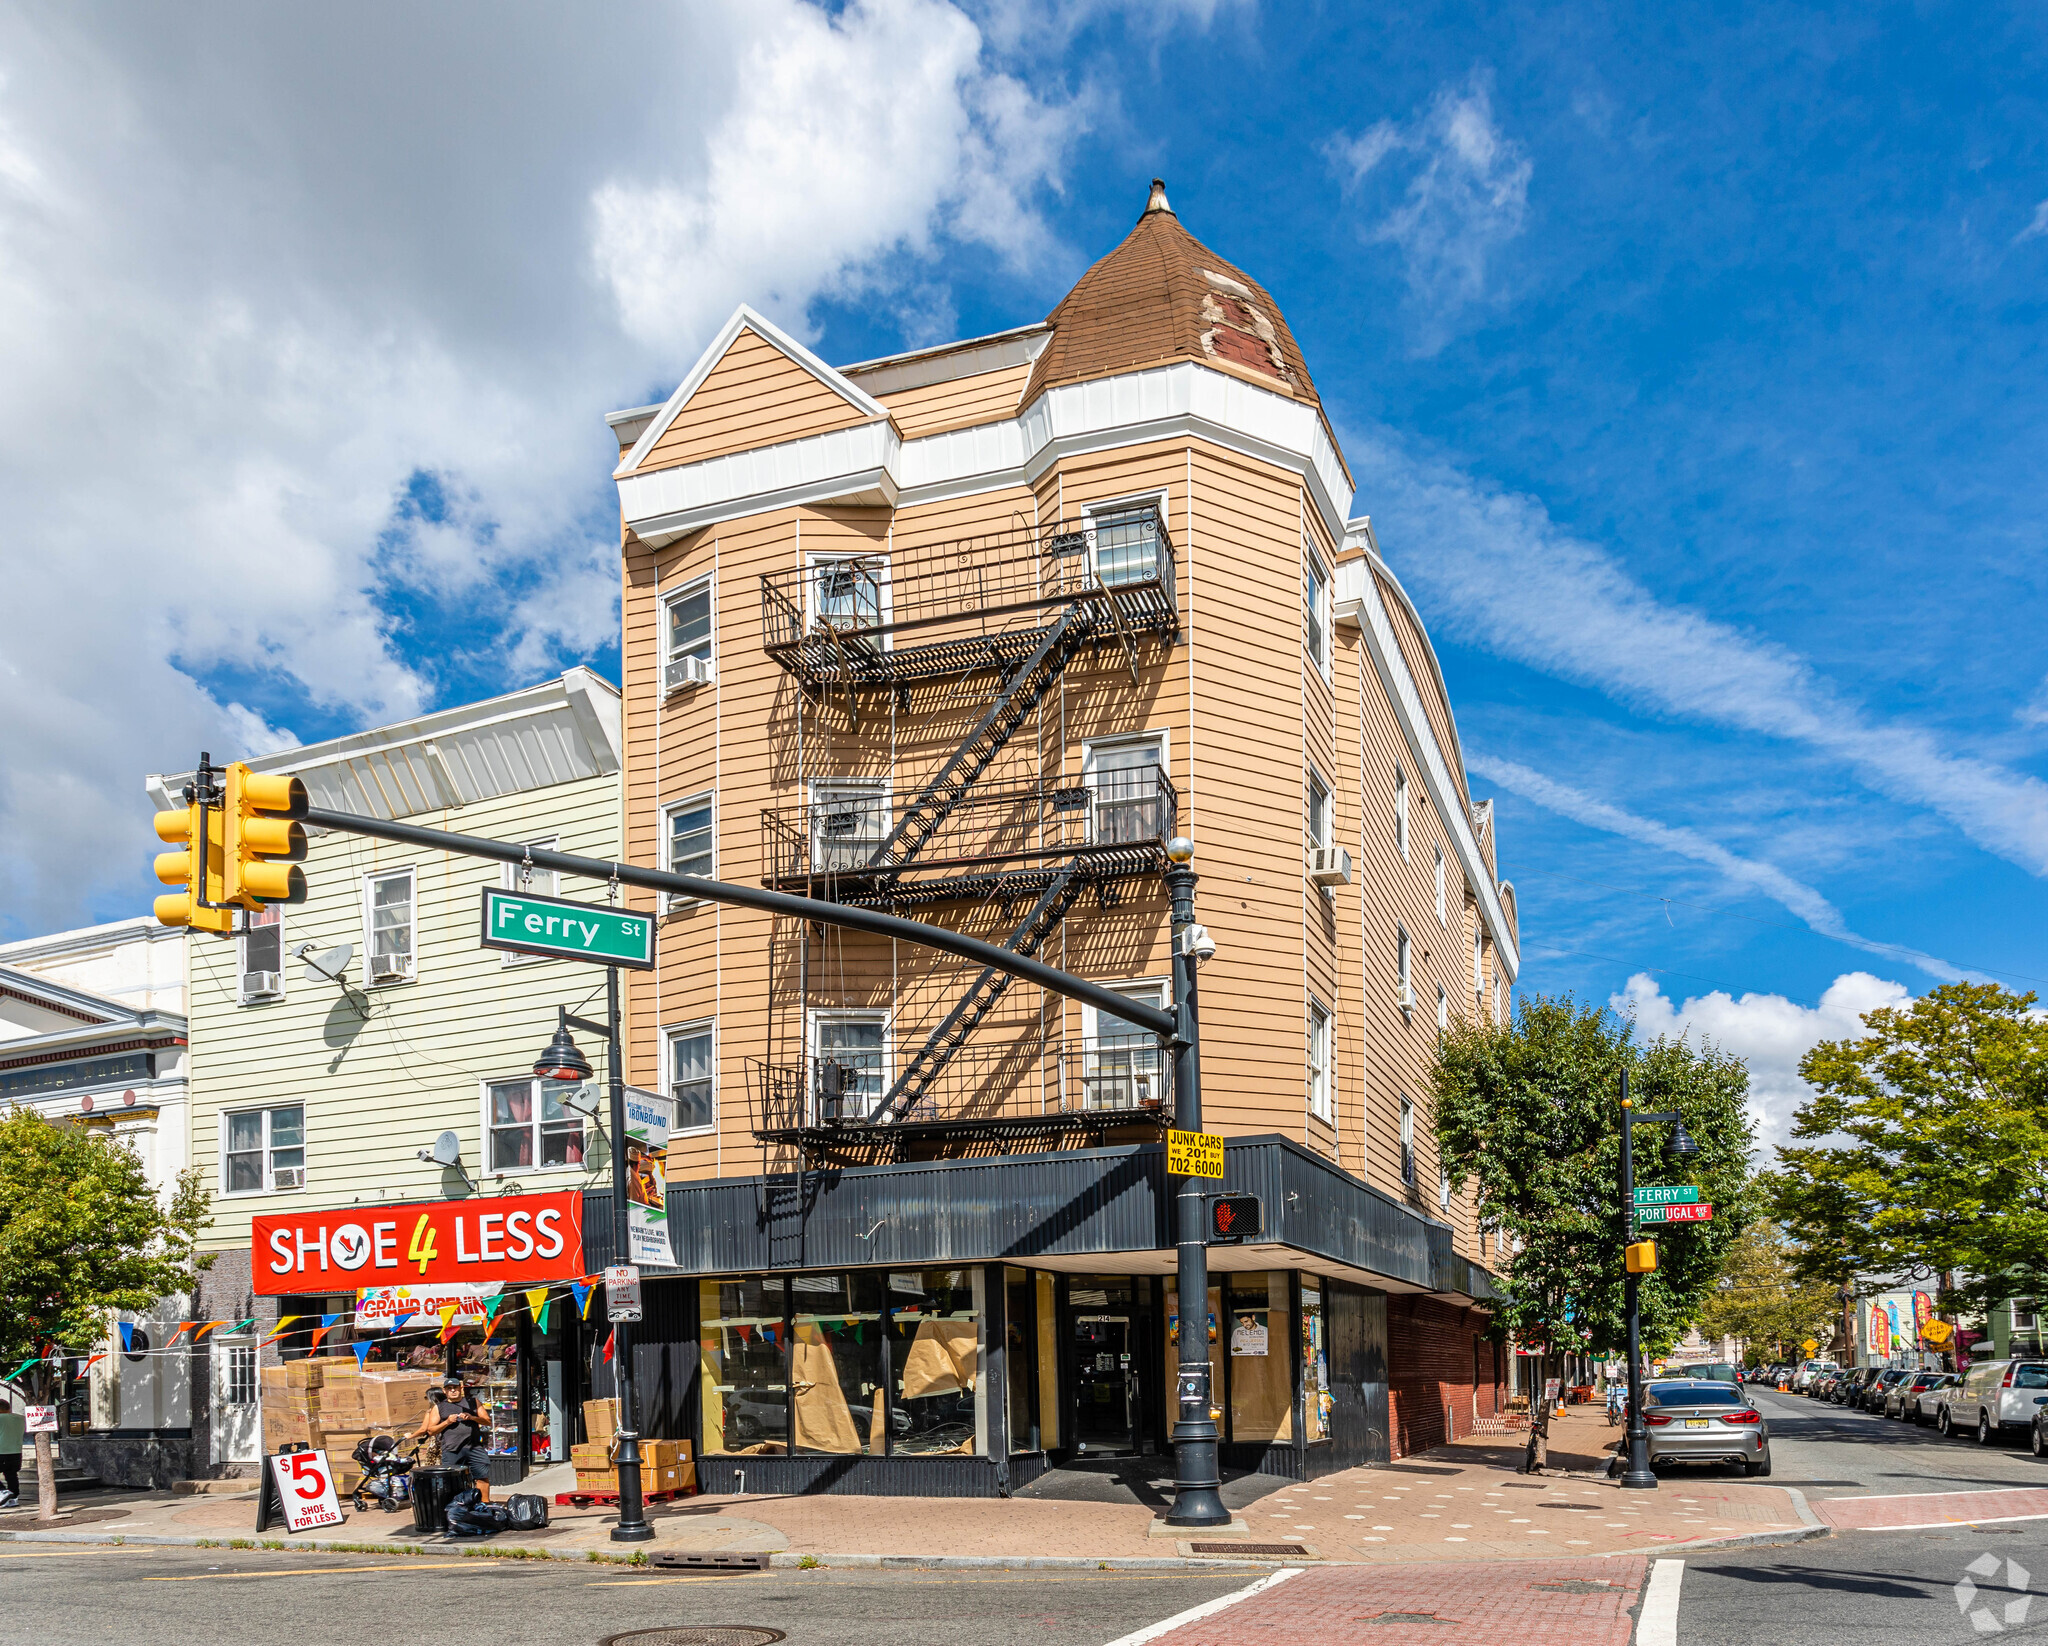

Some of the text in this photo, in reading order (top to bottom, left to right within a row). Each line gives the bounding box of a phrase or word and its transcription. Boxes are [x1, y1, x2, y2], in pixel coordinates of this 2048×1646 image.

[498, 902, 640, 947] Ferry St
[83, 1059, 134, 1081] Bank
[629, 1109, 667, 1128] IRONBOUND
[1170, 1131, 1222, 1149] JUNK CARS
[1186, 1147, 1207, 1159] 201
[1170, 1157, 1222, 1176] 702-6000
[1639, 1189, 1679, 1201] FERRY
[1640, 1206, 1694, 1220] PORTUGAL
[269, 1208, 564, 1275] SHOE 4 LESS
[608, 1278, 637, 1286] PARKING
[616, 1269, 629, 1278] NO
[364, 1295, 496, 1318] GRAND OPNIN
[301, 1504, 325, 1516] SHOE
[294, 1512, 337, 1528] FOR LESS
